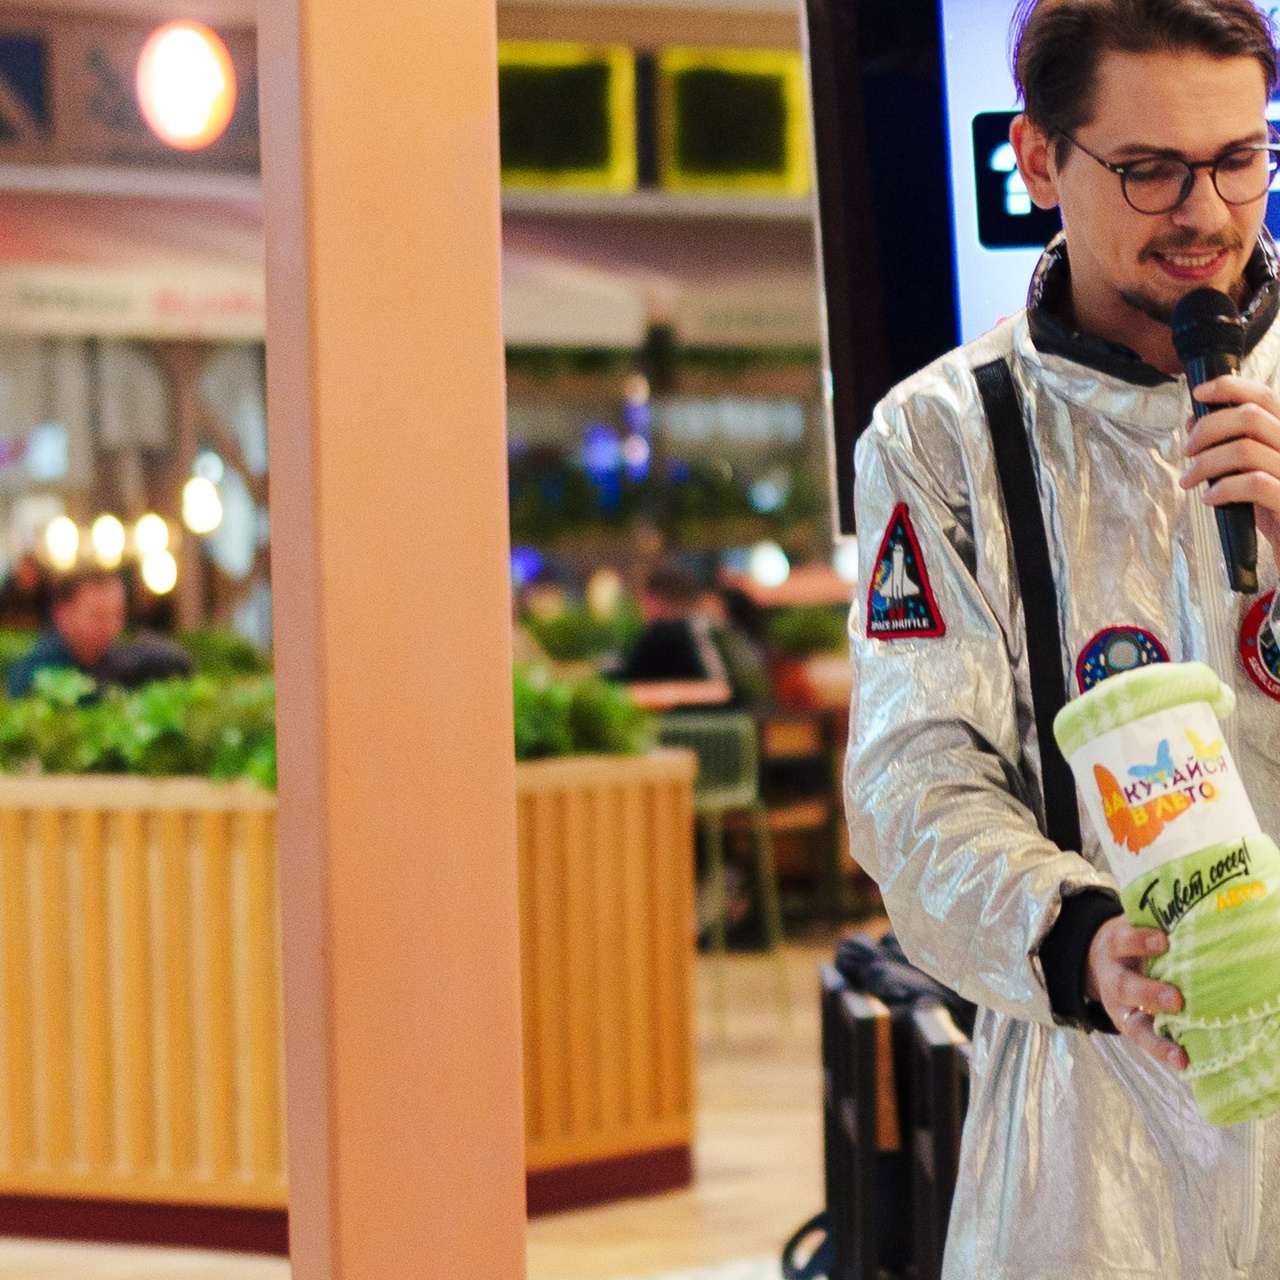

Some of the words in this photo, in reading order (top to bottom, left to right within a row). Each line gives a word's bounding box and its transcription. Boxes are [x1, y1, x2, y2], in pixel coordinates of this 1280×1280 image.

[1103, 755, 1229, 817] ЗАКУТАЙСЯ
[1131, 807, 1149, 827] В
[1156, 781, 1217, 818] ЛЕТО
[1217, 881, 1267, 912] ЛЕТО
